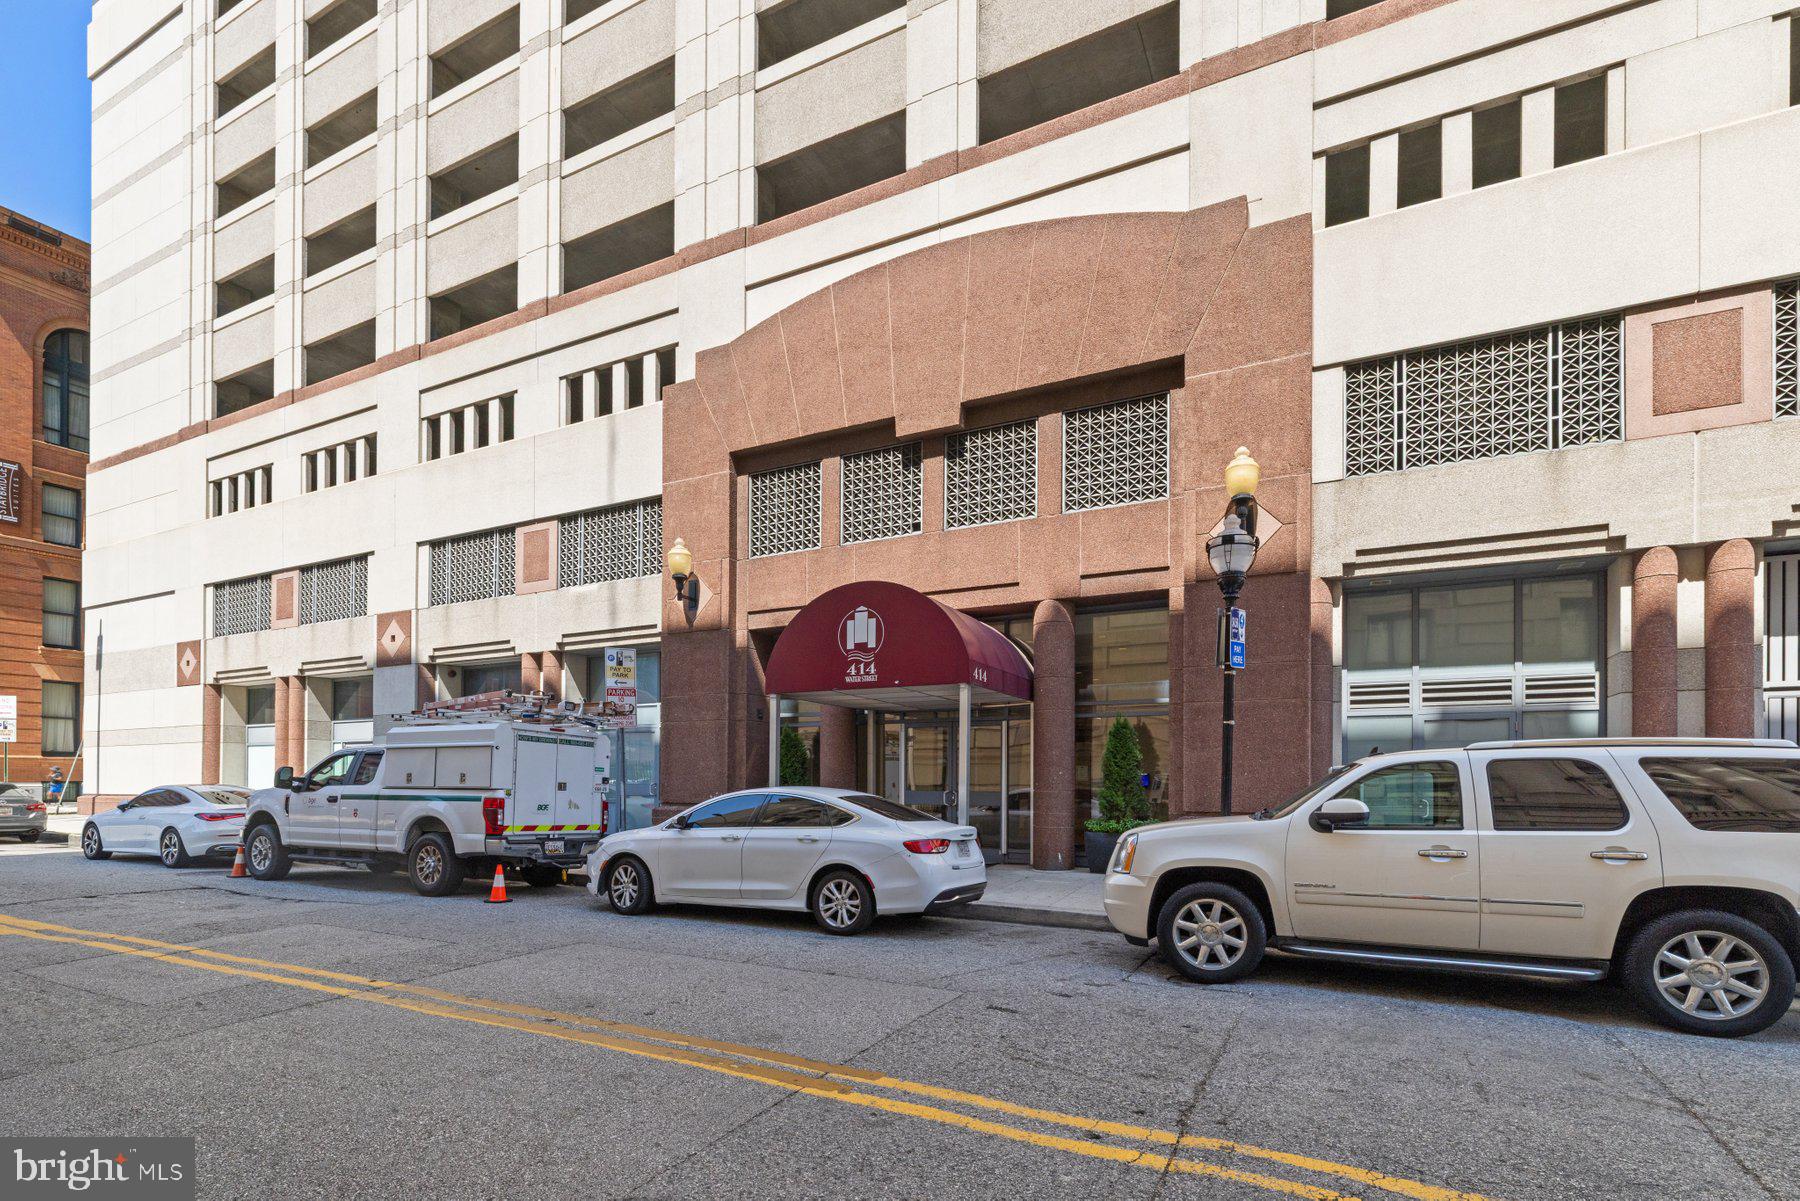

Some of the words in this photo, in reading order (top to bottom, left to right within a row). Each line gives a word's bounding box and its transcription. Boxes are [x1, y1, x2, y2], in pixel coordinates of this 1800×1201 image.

[1233, 645, 1242, 653] PAY
[1233, 655, 1243, 664] HERE
[846, 662, 876, 675] 414
[862, 674, 877, 682] STREET
[973, 667, 987, 682] 414
[607, 688, 635, 697] PARKING
